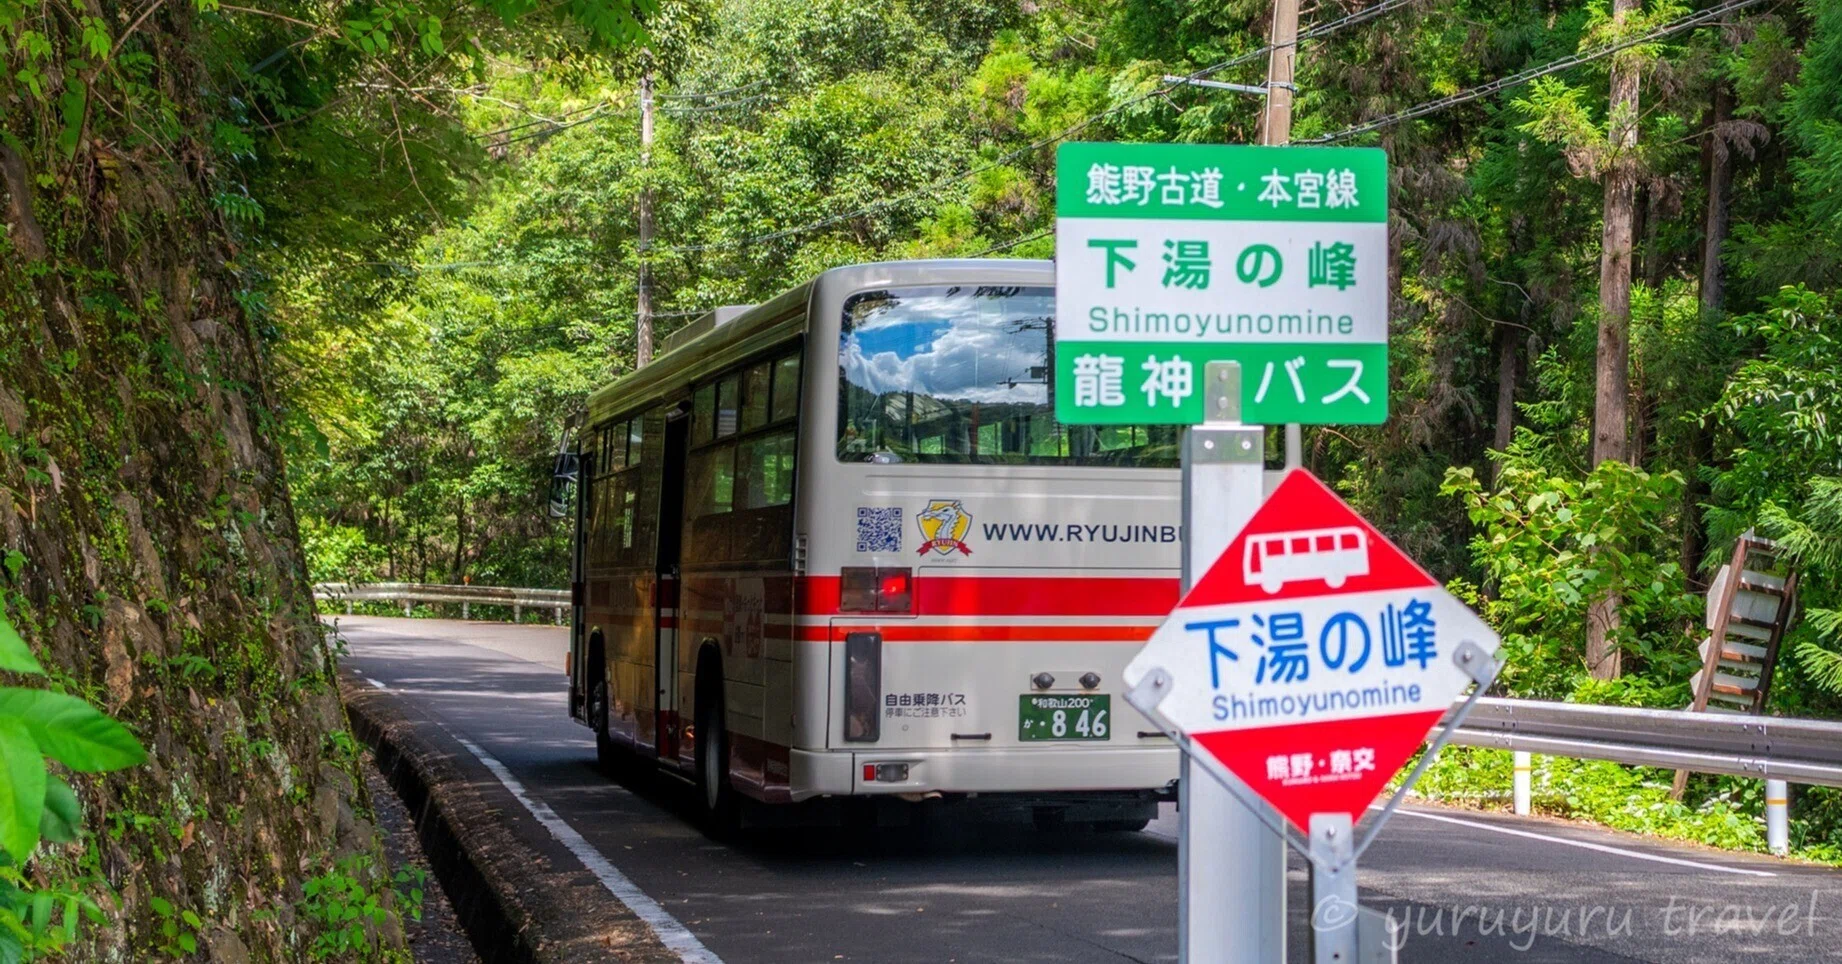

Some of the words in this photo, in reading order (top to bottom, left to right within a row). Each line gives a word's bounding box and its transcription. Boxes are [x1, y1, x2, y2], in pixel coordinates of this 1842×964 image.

[1086, 162, 1360, 209] 熊野古道・本宮線
[1088, 306, 1354, 337] Shimoyunomine
[983, 523, 1183, 543] WWW.RYUJINB
[1185, 598, 1438, 689] 下湯の峰
[885, 693, 967, 706] 自由乗降バス
[1212, 680, 1422, 722] Shimoyunomine
